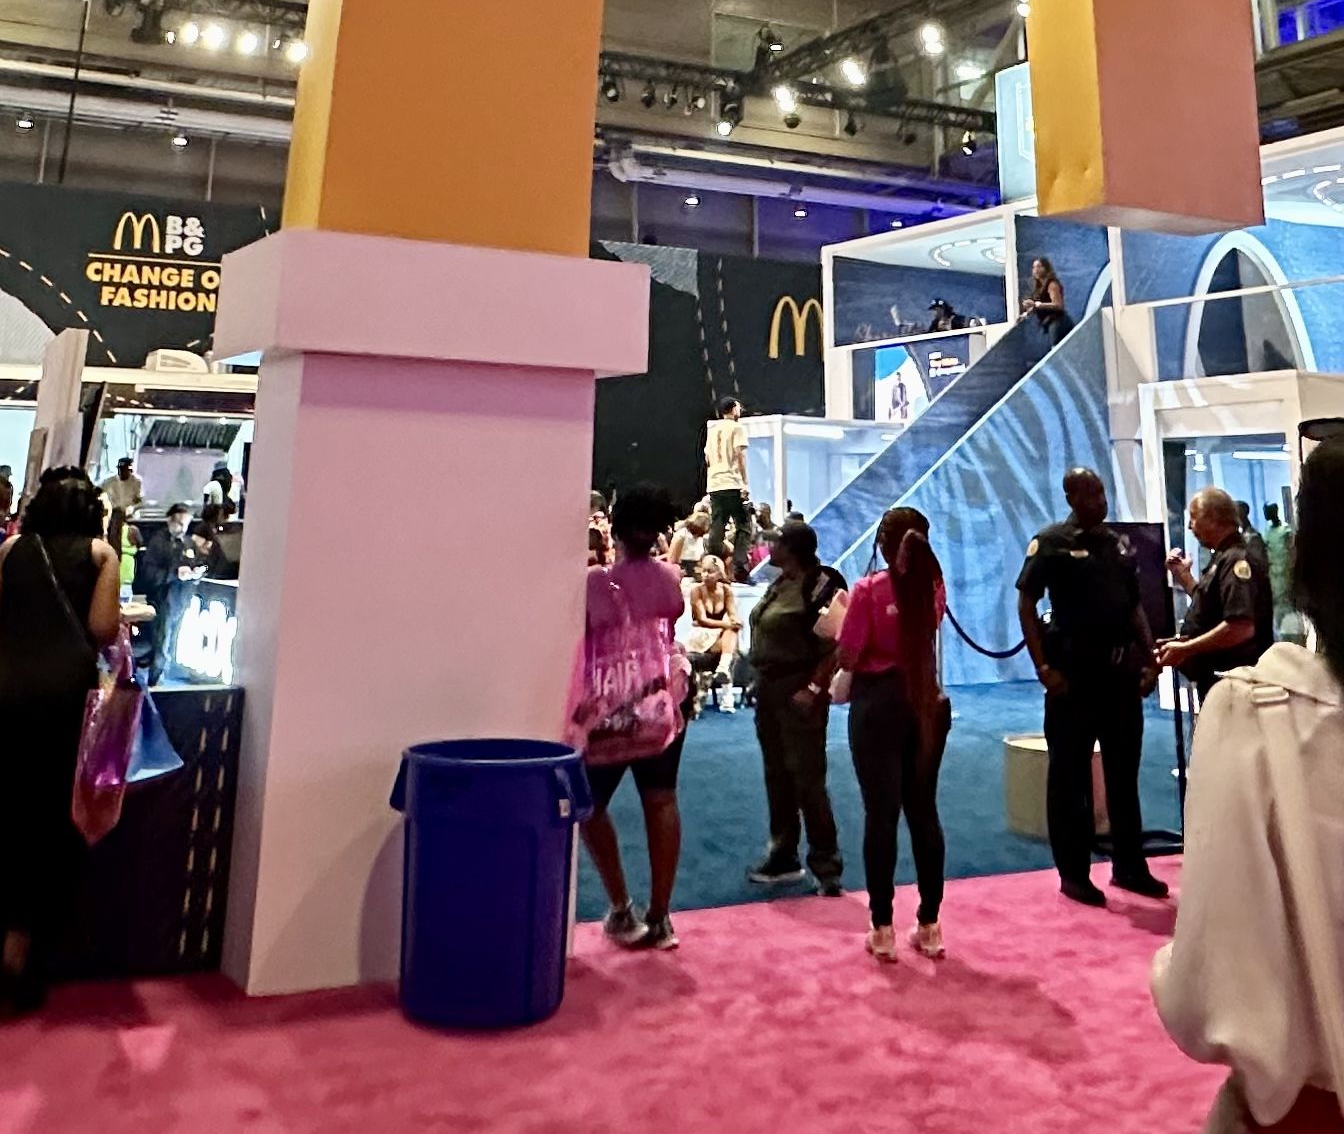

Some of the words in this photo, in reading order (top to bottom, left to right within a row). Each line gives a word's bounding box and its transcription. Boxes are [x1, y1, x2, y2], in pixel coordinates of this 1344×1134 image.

[165, 216, 205, 237] B&
[164, 235, 204, 256] PG
[85, 262, 195, 288] CHANGE
[200, 270, 220, 290] O
[100, 286, 217, 312] FASHION
